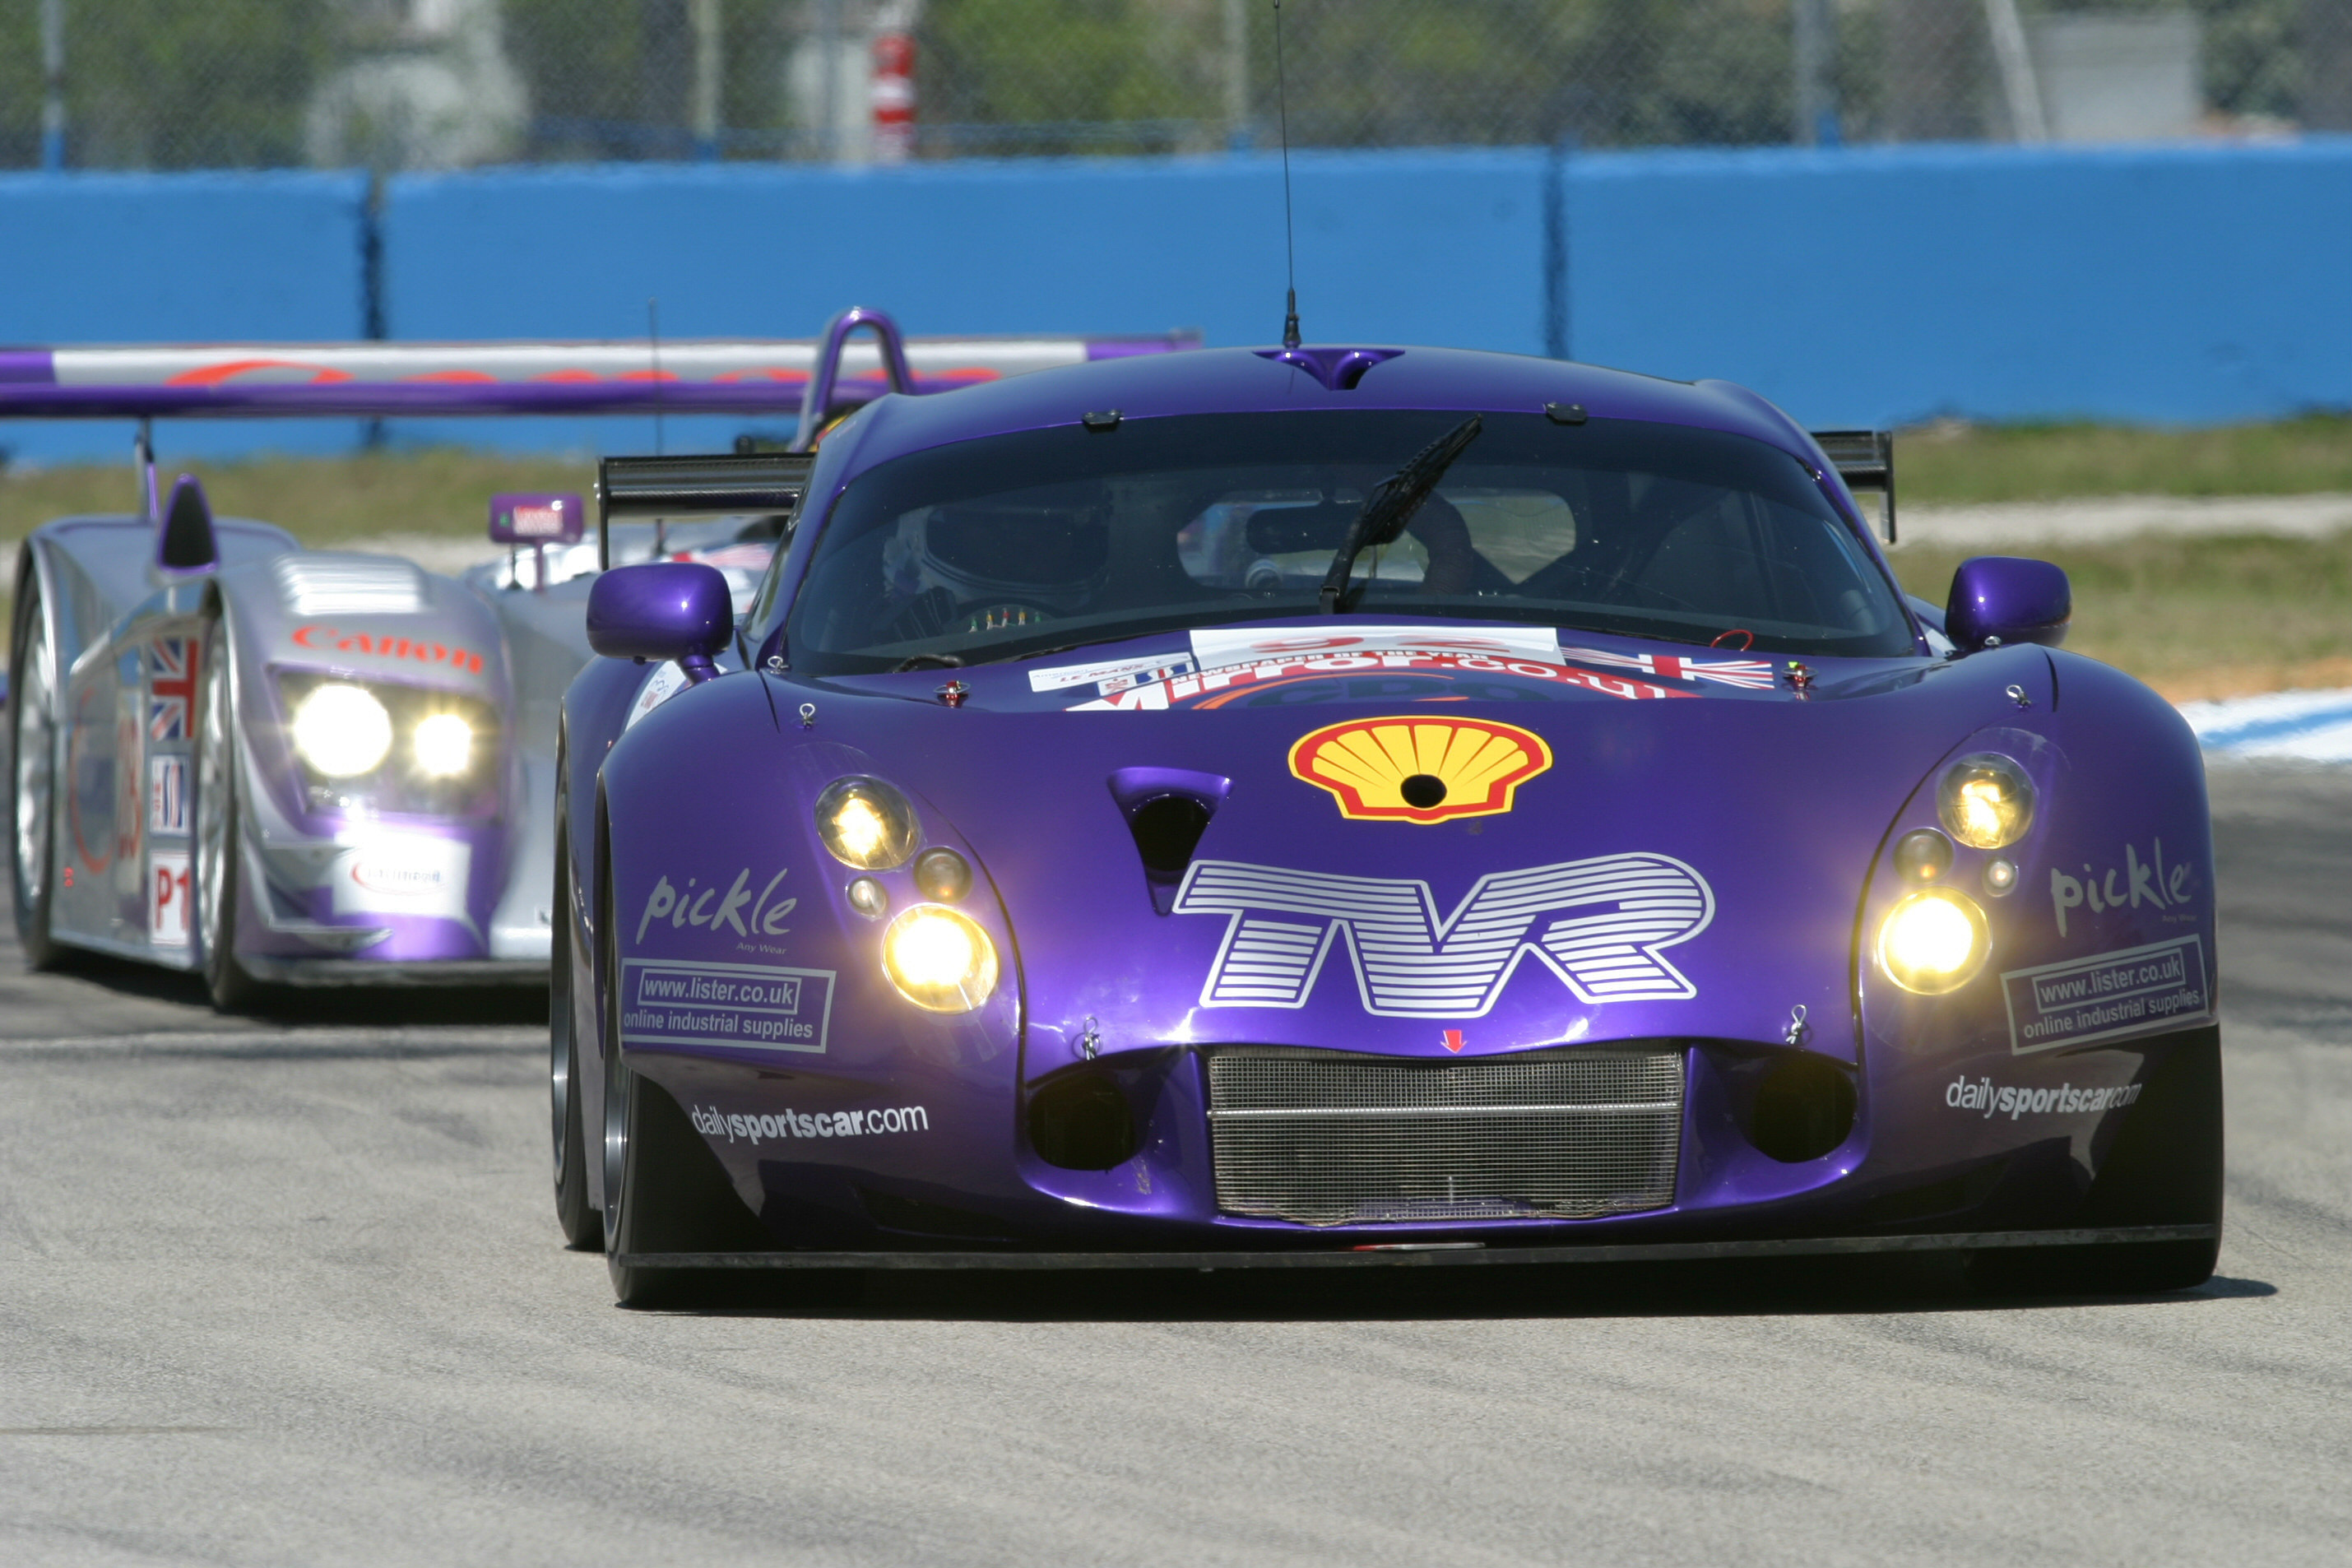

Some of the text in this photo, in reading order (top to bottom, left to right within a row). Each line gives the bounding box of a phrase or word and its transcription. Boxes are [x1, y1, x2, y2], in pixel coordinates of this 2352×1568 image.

[291, 623, 484, 675] Canon
[1089, 664, 1145, 677] MANS
[1426, 651, 1489, 660] YEAR
[1032, 668, 1088, 679] American
[156, 863, 191, 931] P1
[635, 867, 797, 945] pickle
[2049, 837, 2193, 938] pickle
[735, 941, 787, 954] Any Wear
[1171, 852, 1715, 1019] TVR
[644, 976, 795, 1005] www.lister.co.uk
[2040, 957, 2183, 1003] www.lister.co.uk
[624, 1010, 814, 1040] online industrial supplies
[2024, 987, 2201, 1039] online industrial supplies
[693, 1103, 930, 1144] dailysportscar.com
